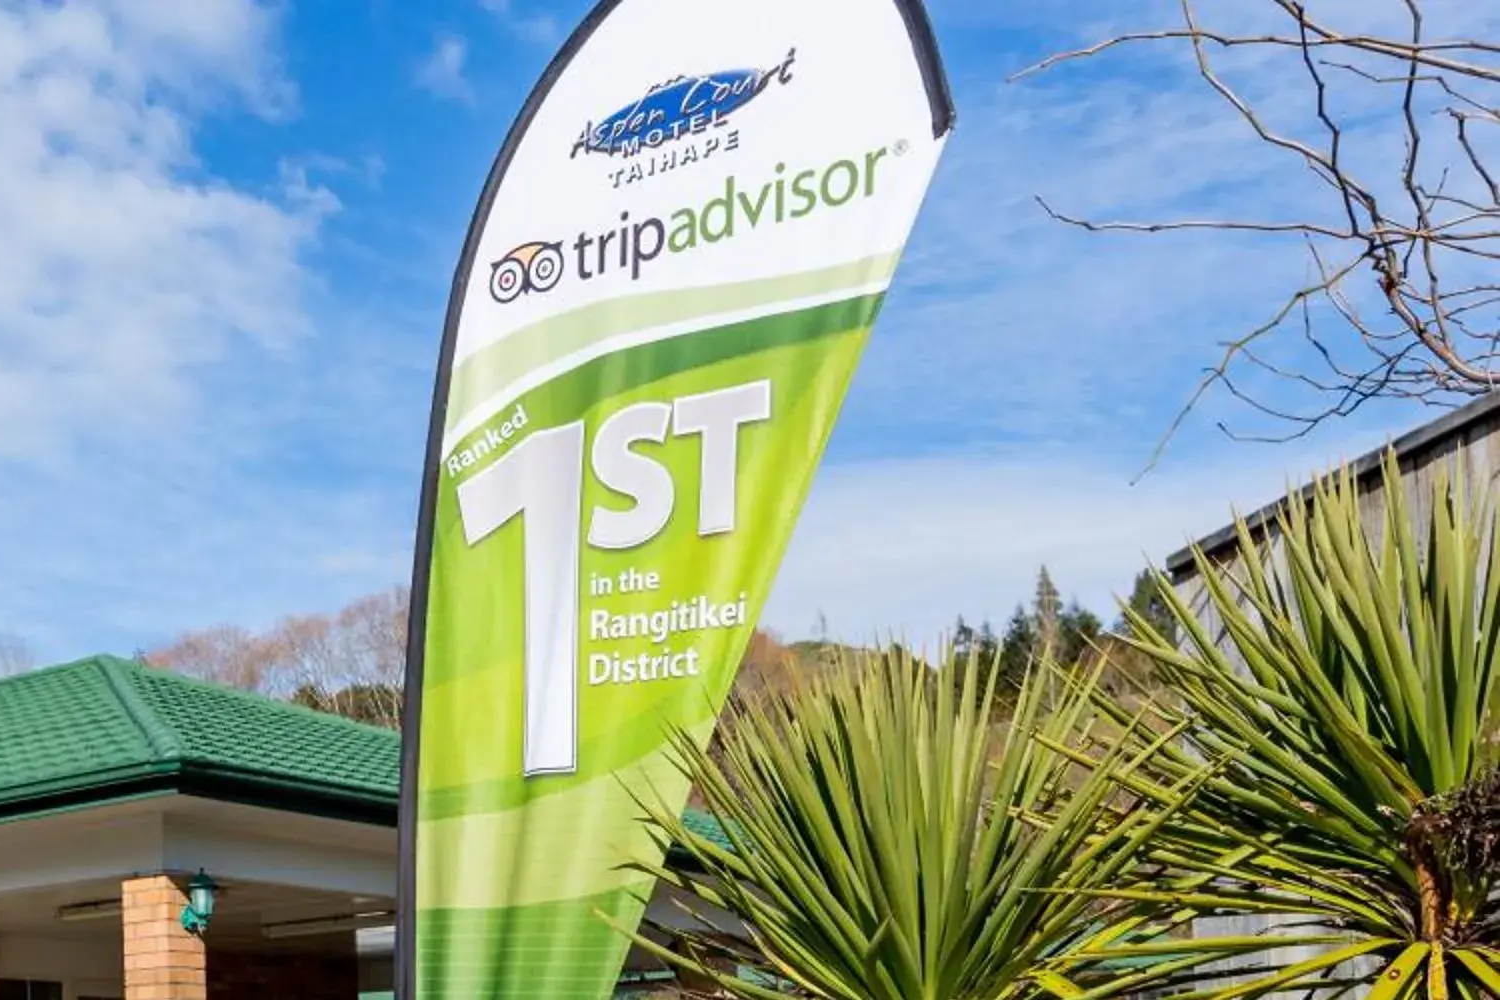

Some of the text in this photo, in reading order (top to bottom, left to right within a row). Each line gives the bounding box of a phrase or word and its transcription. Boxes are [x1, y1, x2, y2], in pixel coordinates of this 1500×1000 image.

[570, 47, 797, 159] Aspen Court
[608, 130, 739, 188] TAIHAPE
[621, 108, 728, 158] MOTEL
[573, 144, 887, 280] tripadvisor
[446, 405, 529, 478] Ranked
[456, 379, 771, 777] 1ST
[590, 567, 660, 596] in the
[589, 593, 746, 643] Rangitikei
[587, 648, 699, 687] District
